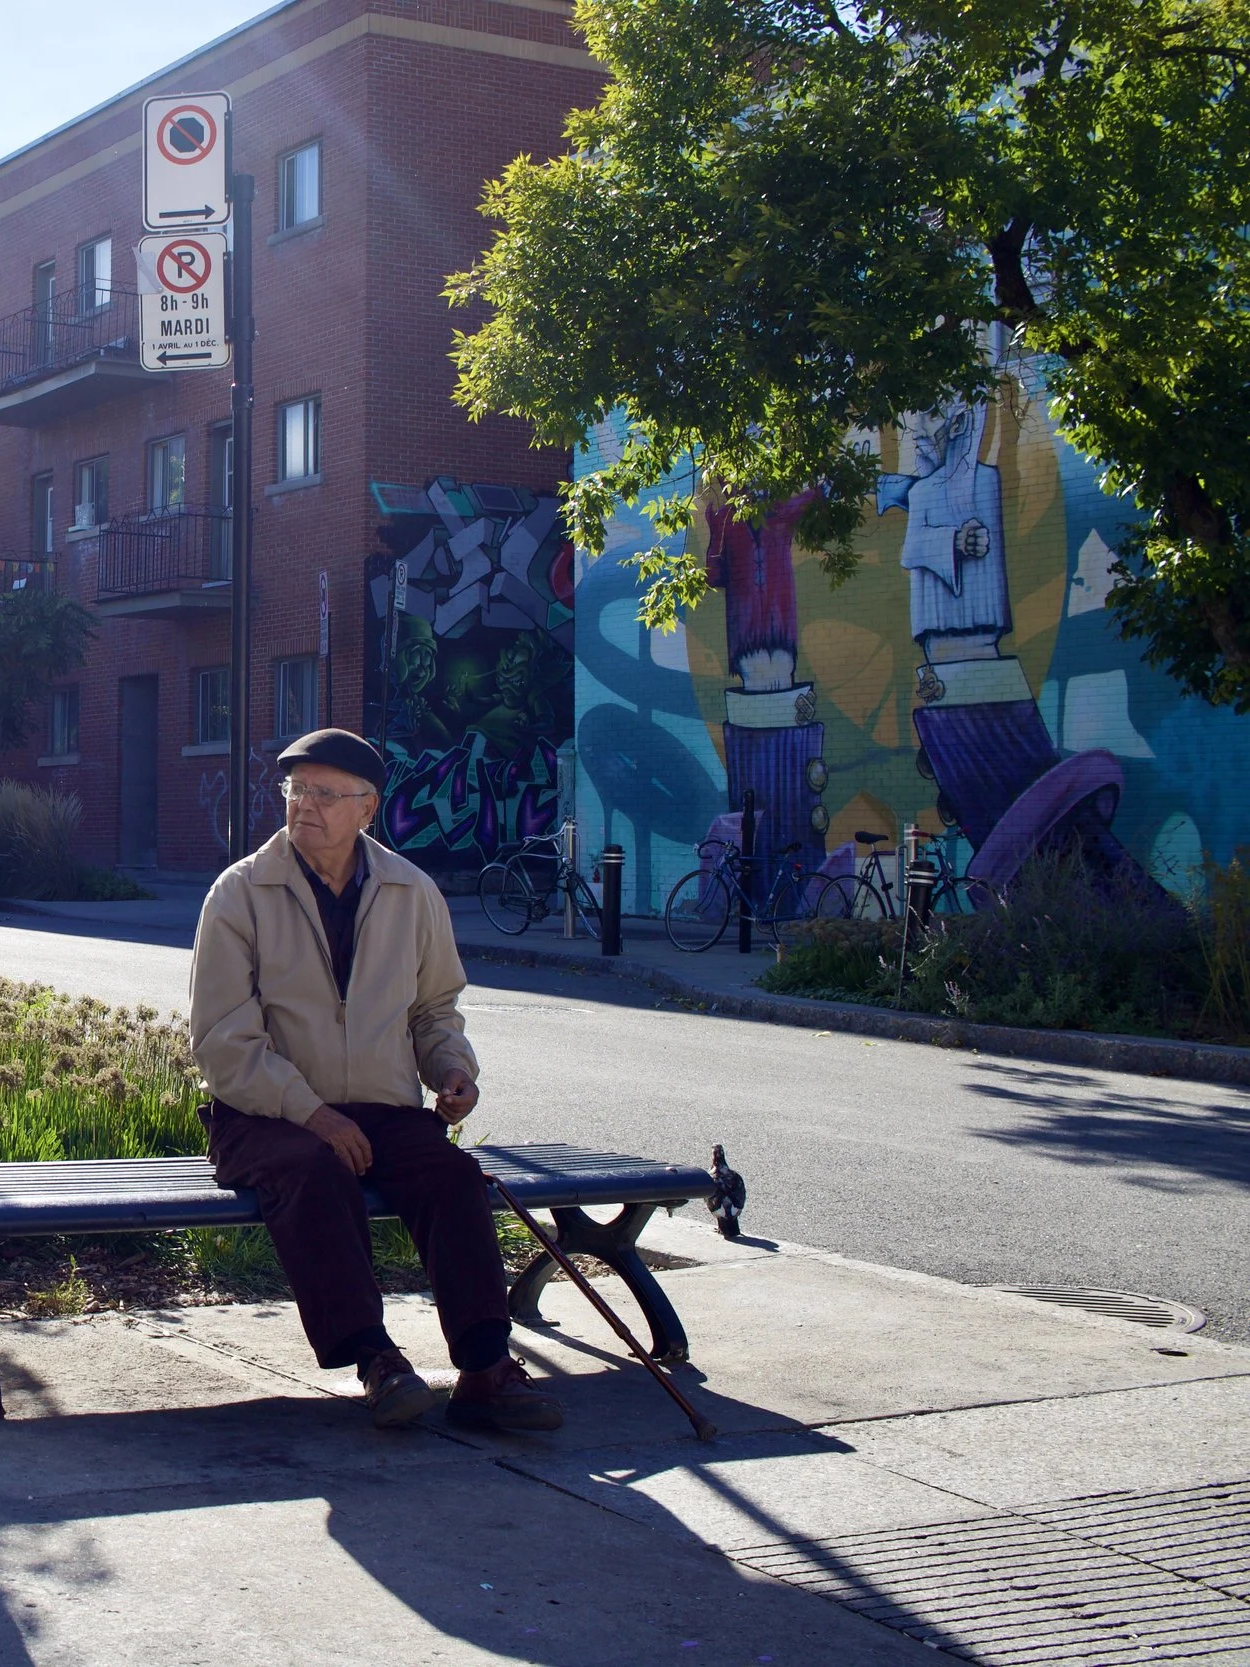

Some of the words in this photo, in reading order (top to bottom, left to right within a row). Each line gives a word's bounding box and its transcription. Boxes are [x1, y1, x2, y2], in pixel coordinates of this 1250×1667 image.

[160, 295, 178, 311] 8h
[191, 293, 209, 310] 9h
[160, 318, 210, 337] MARDI
[158, 342, 180, 350] AVRIL
[200, 338, 219, 348] DÉC.
